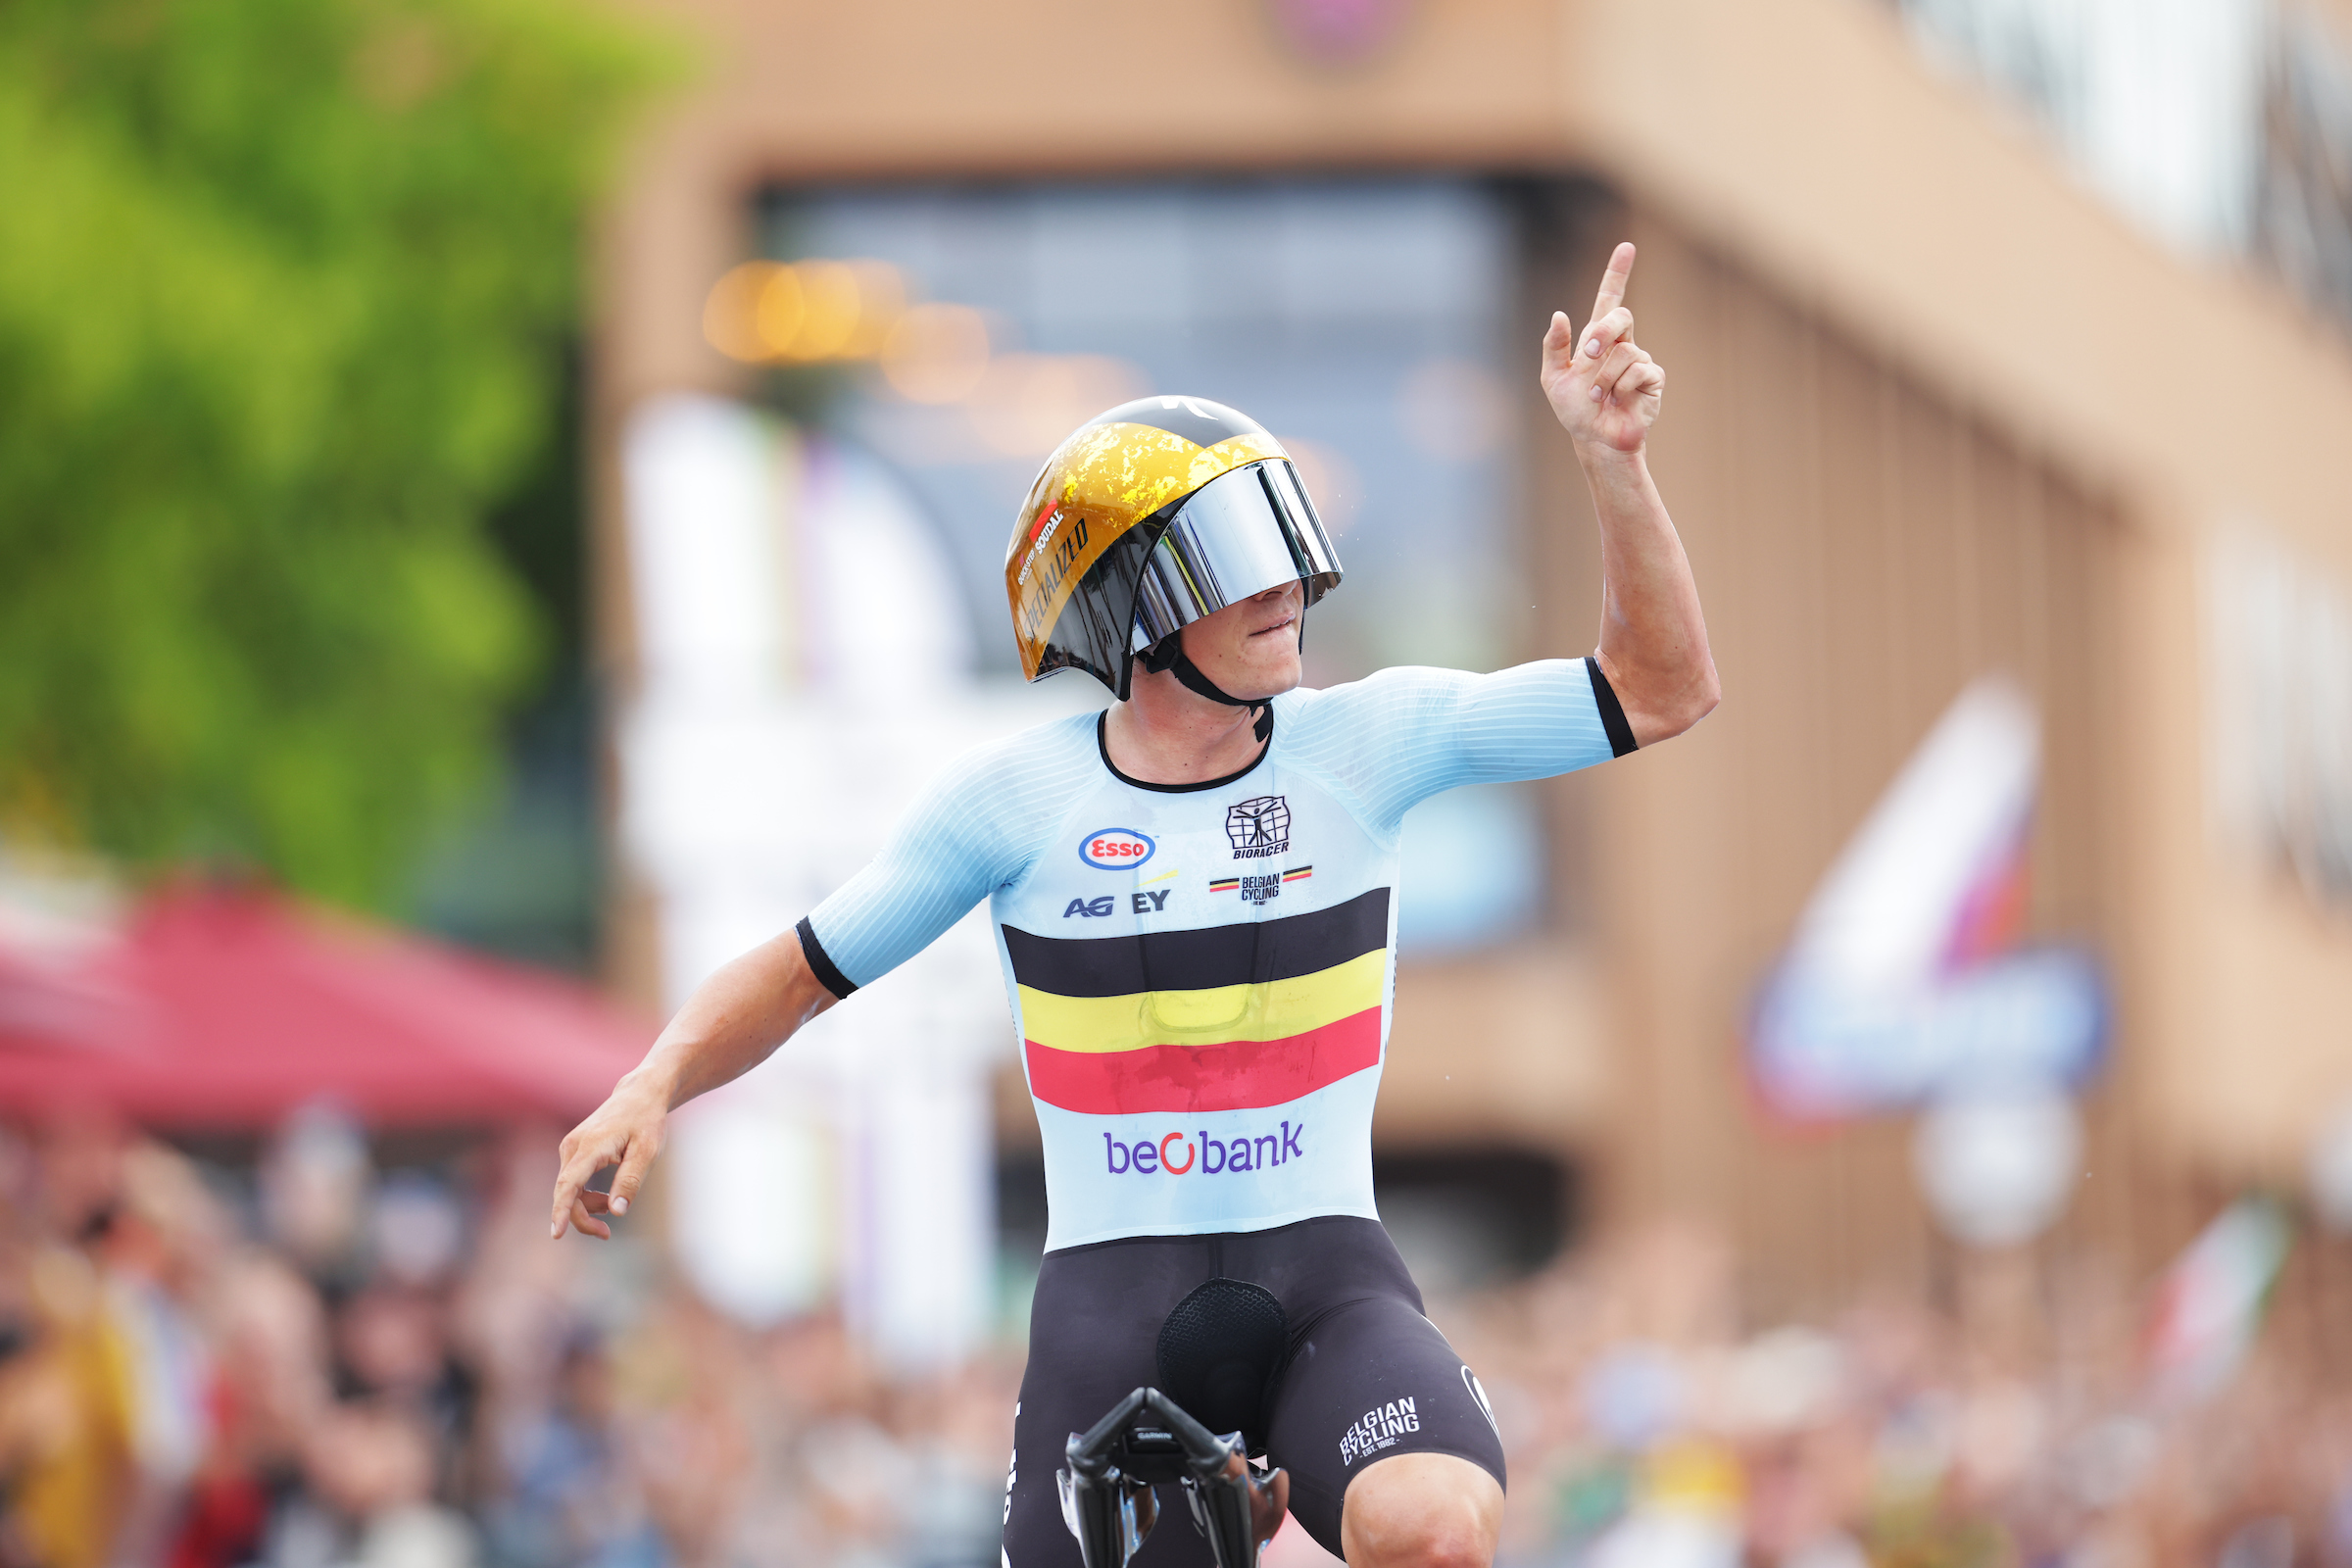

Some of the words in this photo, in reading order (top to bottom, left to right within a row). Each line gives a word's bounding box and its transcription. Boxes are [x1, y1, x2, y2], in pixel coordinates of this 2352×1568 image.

[1035, 509, 1064, 555] SOUDAL
[1024, 517, 1089, 649] SPECIALIZED
[1092, 840, 1145, 858] Esso
[1233, 842, 1290, 859] BIORACER
[1242, 872, 1280, 889] BELGIAN
[1131, 889, 1171, 914] EY
[1242, 885, 1280, 901] CYCLING
[1062, 896, 1115, 918] AG
[1339, 1396, 1416, 1455] BELGIAN
[1343, 1413, 1420, 1466] CYCLING
[1361, 1445, 1378, 1457] EST.
[1377, 1437, 1396, 1449] 1882
